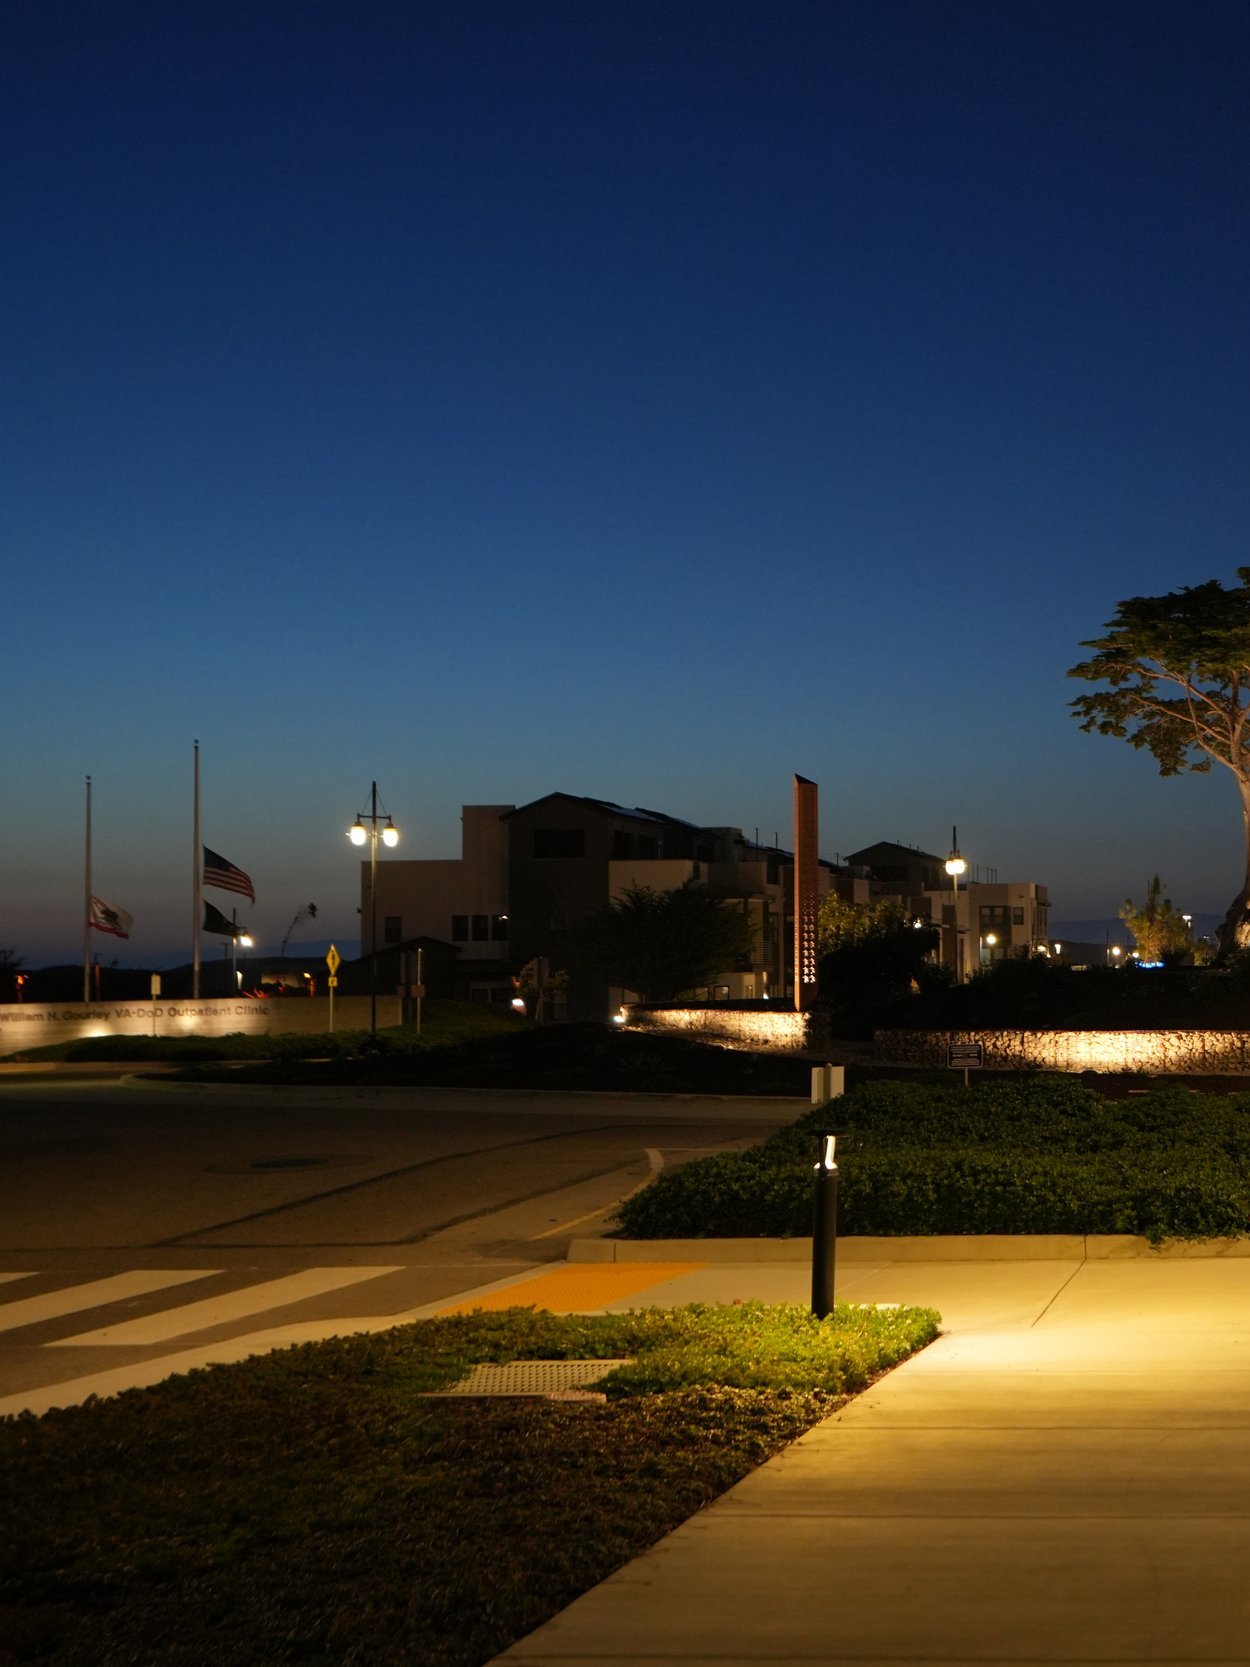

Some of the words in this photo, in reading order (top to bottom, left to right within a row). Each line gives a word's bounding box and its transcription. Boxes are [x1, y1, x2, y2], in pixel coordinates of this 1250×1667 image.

[0, 1011, 44, 1022] William
[62, 1009, 110, 1022] Gourley
[115, 1007, 163, 1019] VA-DoD
[167, 1005, 231, 1018] Outpatient
[235, 1004, 270, 1016] Clinic
